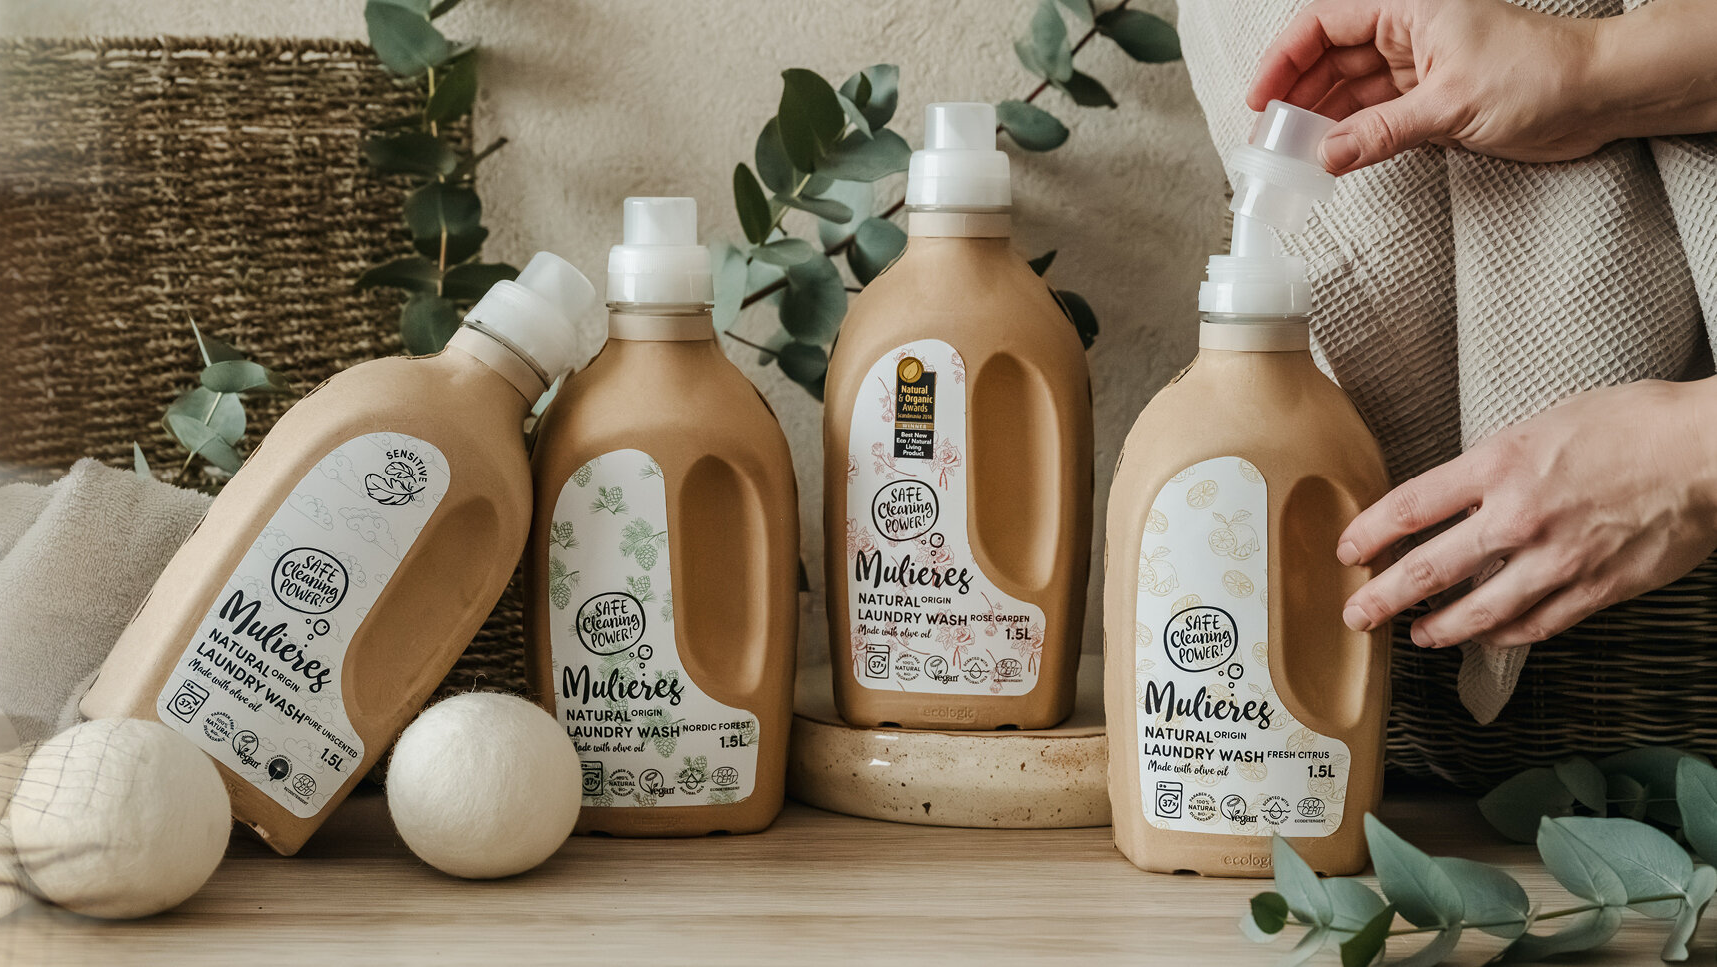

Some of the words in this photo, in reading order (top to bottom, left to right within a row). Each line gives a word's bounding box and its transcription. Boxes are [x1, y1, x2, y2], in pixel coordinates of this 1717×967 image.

[901, 385, 928, 394] Natural
[898, 394, 904, 403] &
[905, 394, 933, 405] Organic
[902, 403, 928, 412] Awards
[902, 449, 925, 457] Product
[386, 449, 427, 482] SENSITIVE
[891, 486, 923, 503] SAFE
[877, 499, 934, 519] Cleaning
[884, 516, 926, 533] POWER!
[302, 555, 340, 584] SAFE
[855, 549, 975, 595] Mulieres
[282, 560, 339, 604] Cleaning
[280, 578, 327, 608] POWER!
[858, 592, 921, 608] NATURAL
[921, 596, 952, 604] ORIGIN
[595, 599, 629, 617] SAFE
[858, 608, 923, 624] LAUNDRY
[926, 613, 968, 626] WASH
[970, 614, 993, 622] ROSE
[995, 614, 1030, 623] GARDEN
[582, 613, 640, 634] Cleaning
[857, 624, 881, 635] Made
[882, 625, 899, 638] with
[900, 627, 920, 639] olive
[921, 628, 933, 639] oil
[1185, 613, 1221, 632] SAFE
[219, 589, 332, 694] Mulieres
[590, 627, 633, 649] POWER!
[1004, 627, 1032, 641] 1.5L
[1170, 630, 1232, 648] Cleaning
[209, 627, 273, 679] NATURAL
[271, 669, 301, 693] ORIGIN
[1179, 646, 1224, 664] POWER!
[188, 657, 213, 679] Made
[211, 675, 230, 692] with
[229, 686, 249, 705] olive
[248, 700, 262, 713] oil
[562, 664, 685, 707] Mulieres
[934, 673, 960, 685] Vegan
[196, 641, 267, 694] LAUNDRY
[264, 687, 306, 724] WASH
[304, 715, 322, 733] PURE
[321, 727, 359, 759] UNSCENTED
[1144, 679, 1275, 730] Mulieres
[566, 708, 632, 722] NATURAL
[631, 708, 663, 717] ORIGIN
[205, 717, 231, 739] NATURAL
[567, 725, 633, 739] LAUNDRY
[637, 725, 680, 739] WASH
[682, 723, 717, 732] NORDIC
[718, 721, 751, 731] FOREST
[1145, 725, 1214, 744] NATURAL
[1213, 730, 1247, 740] ORIGIN
[593, 741, 611, 753] with
[612, 741, 633, 753] olive
[634, 741, 646, 753] oil
[719, 735, 747, 749] 1.5L
[320, 747, 346, 772] 1.5L
[1144, 743, 1215, 761] LAUNDRY
[1219, 749, 1265, 763] WASH
[1267, 750, 1296, 759] FRESH
[1297, 751, 1330, 759] CITRUS
[1147, 759, 1173, 773] Made
[1173, 762, 1193, 774] with
[1193, 765, 1215, 777] olive
[1216, 765, 1230, 777] oil
[1307, 765, 1336, 778] 1.5L
[1188, 804, 1217, 812] NATURAL
[1263, 795, 1280, 807] SCENTED
[1280, 797, 1290, 807] WITH
[1230, 813, 1259, 826] Vegan
[1223, 853, 1272, 868] ecologi
